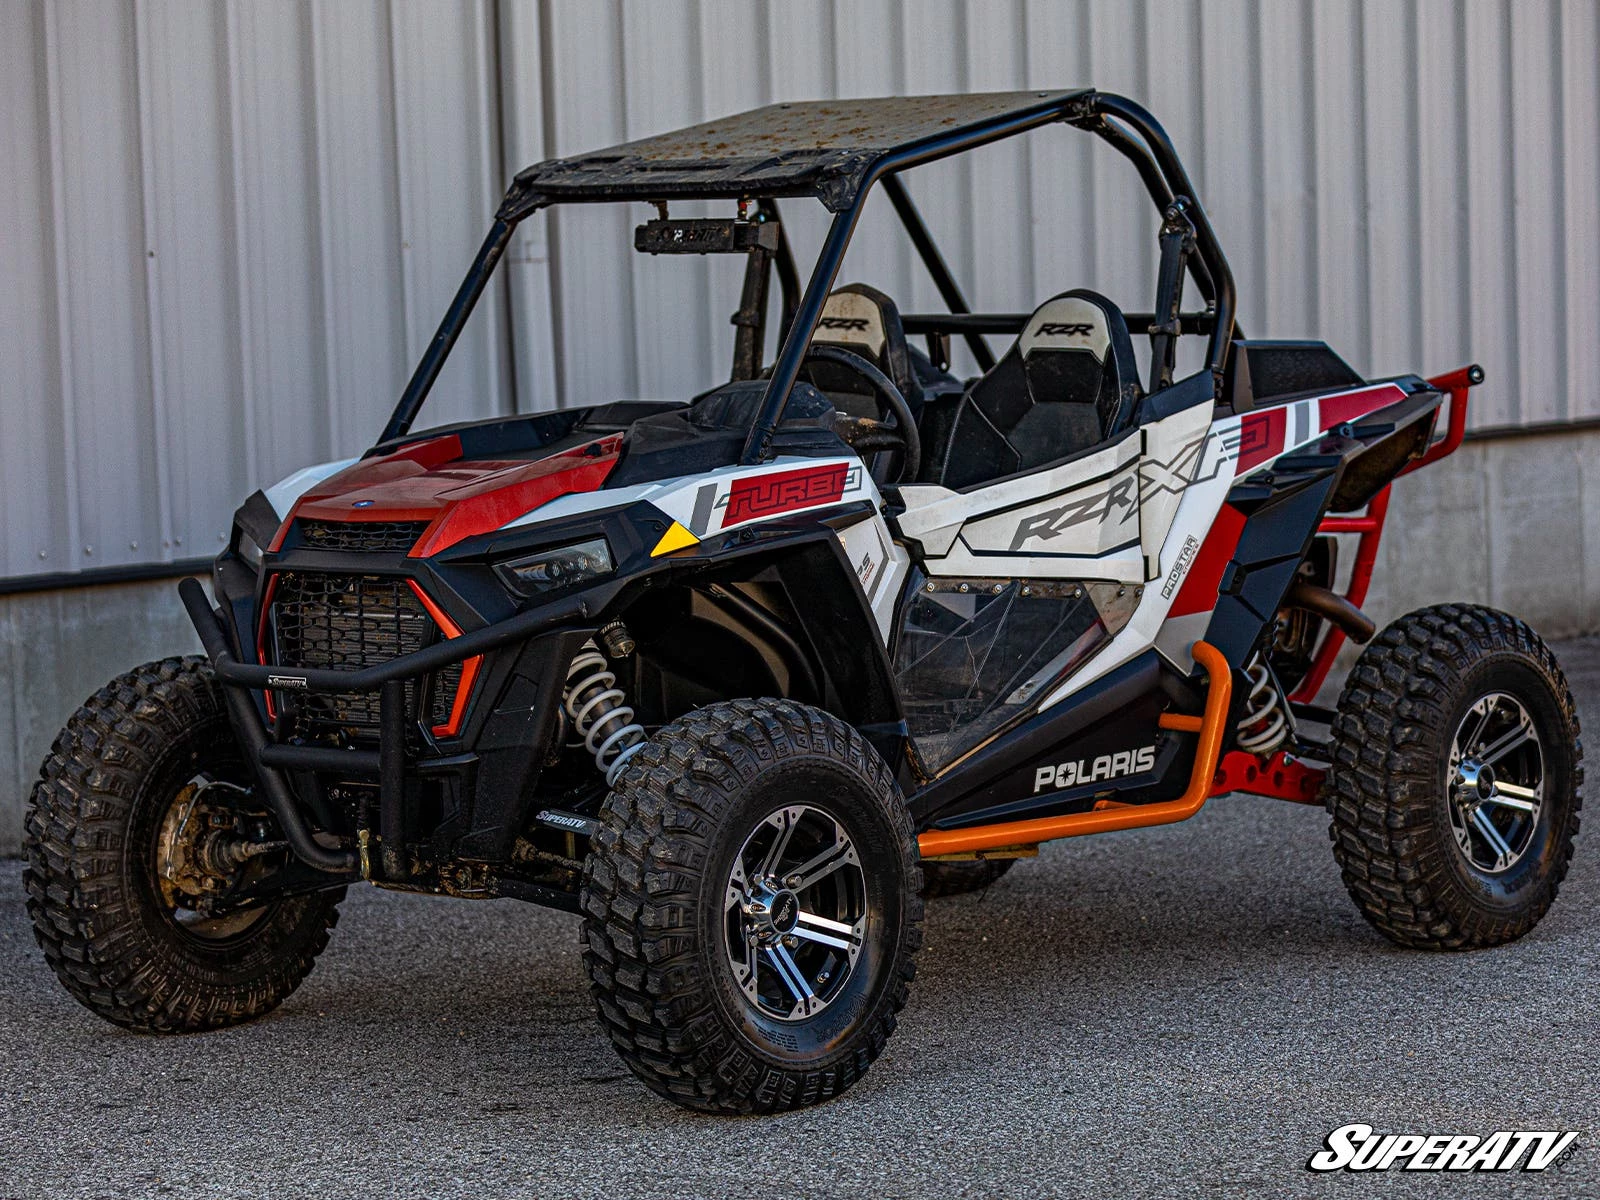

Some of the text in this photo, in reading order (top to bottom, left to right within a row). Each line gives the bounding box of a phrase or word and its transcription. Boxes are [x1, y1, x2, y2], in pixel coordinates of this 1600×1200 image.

[1033, 322, 1095, 337] RZR
[713, 465, 863, 519] TURBO
[1007, 415, 1271, 552] RZR XP
[1161, 534, 1197, 600] PROSTAR
[1033, 745, 1156, 793] POLARIS
